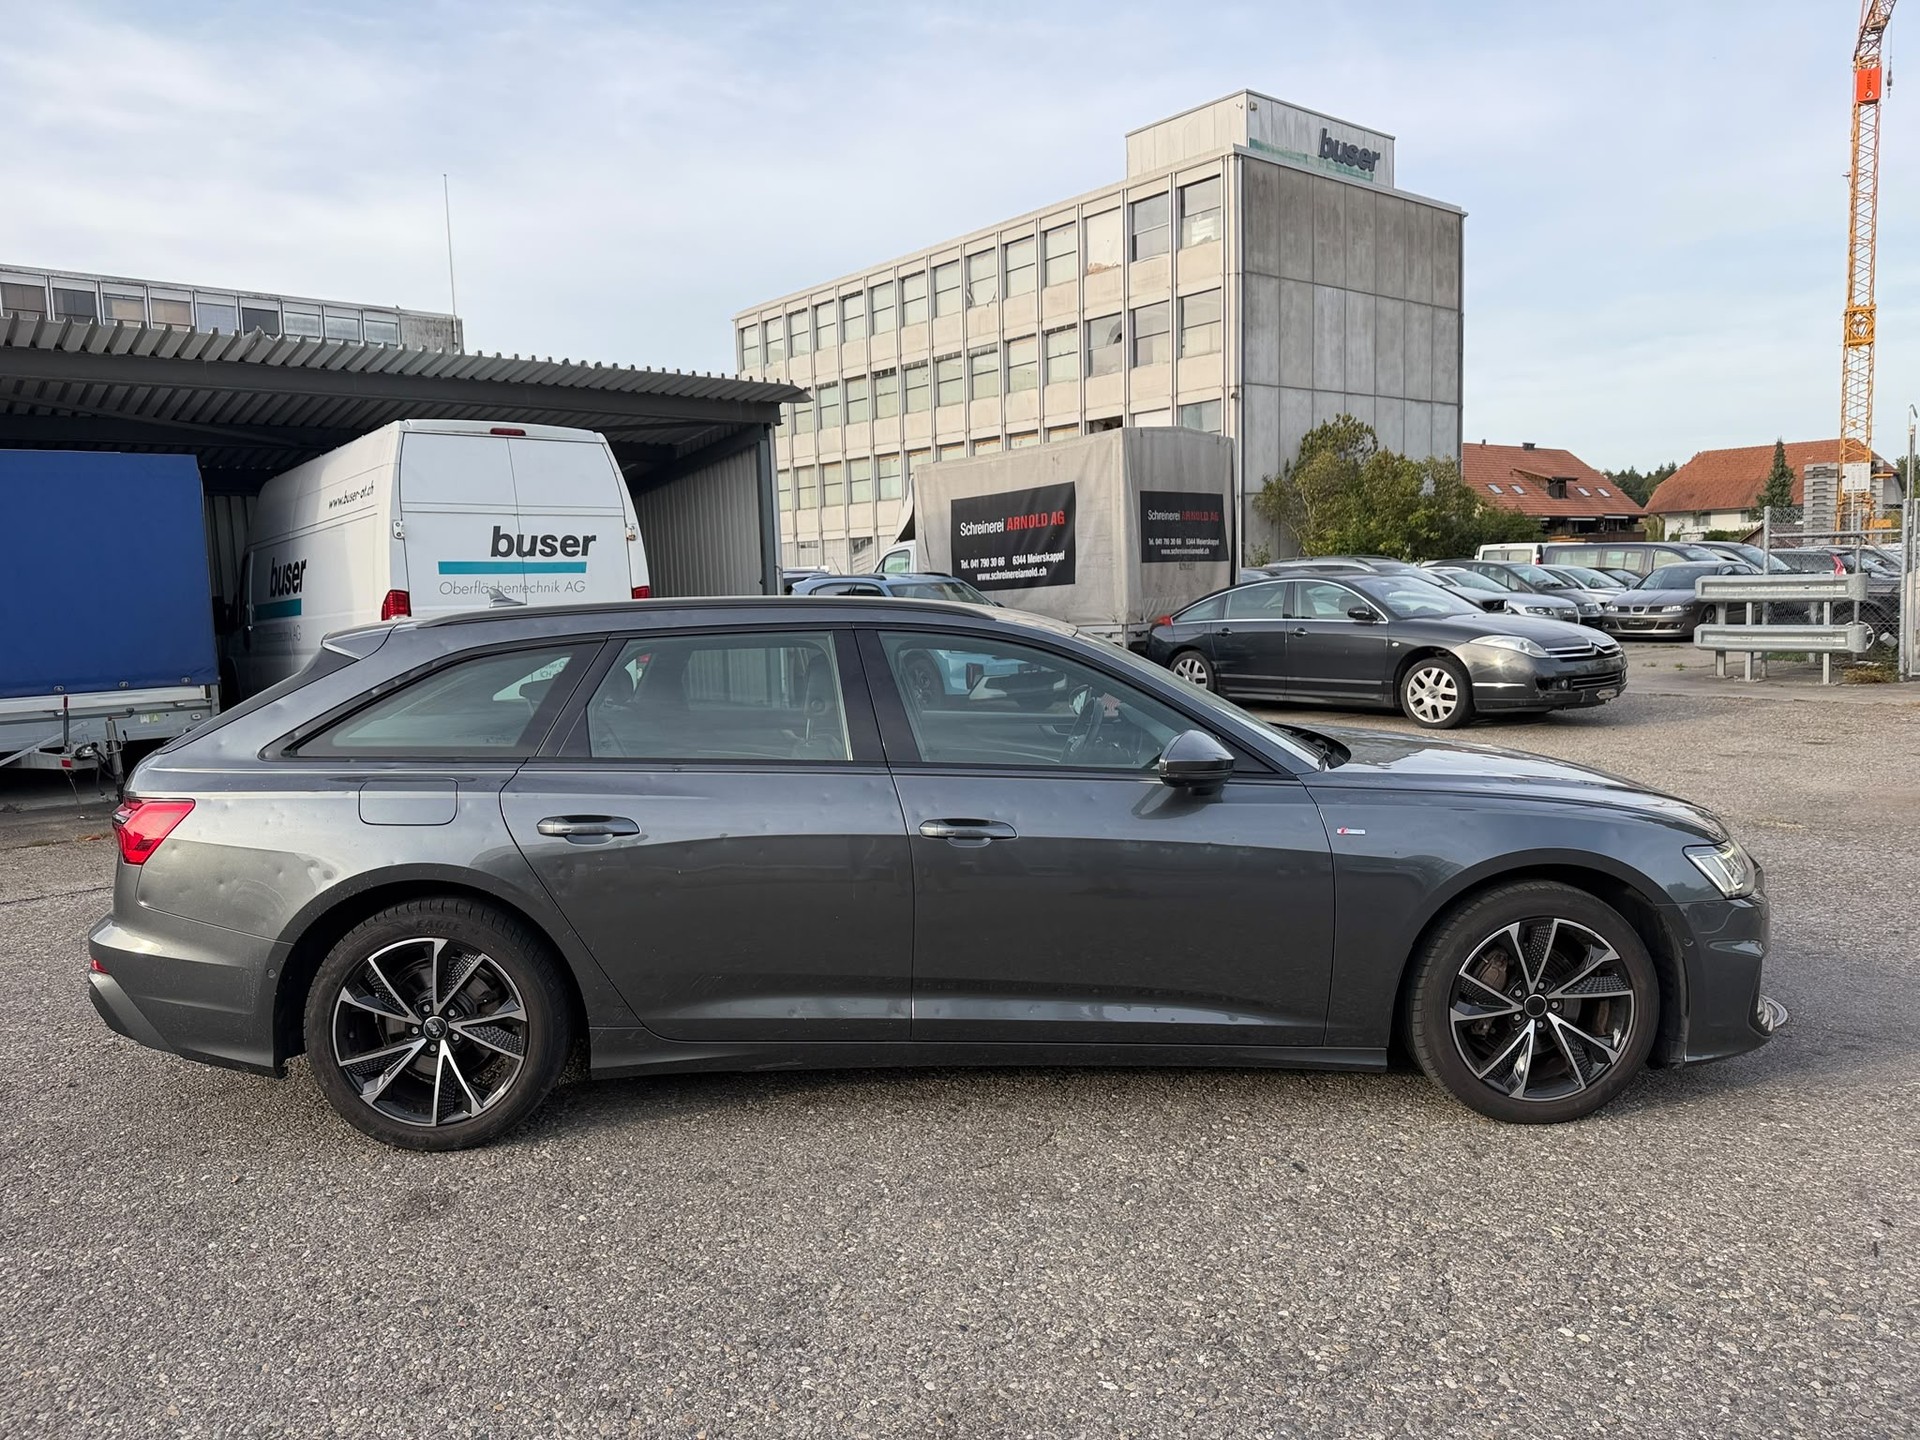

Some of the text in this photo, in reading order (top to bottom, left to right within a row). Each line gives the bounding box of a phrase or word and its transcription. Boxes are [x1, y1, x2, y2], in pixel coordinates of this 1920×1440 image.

[1319, 128, 1381, 172] buser
[960, 510, 1065, 536] Schreinerei ARNOLD AG
[1147, 509, 1220, 521] Schreinerei ARNOLD AG
[490, 526, 597, 558] buser
[960, 550, 1065, 569] Tel. 041 790 30 66 6344 Meierskappel
[270, 557, 307, 598] buser
[977, 566, 1047, 581] www.schreinereiarnold.ch
[564, 580, 586, 593] AG
